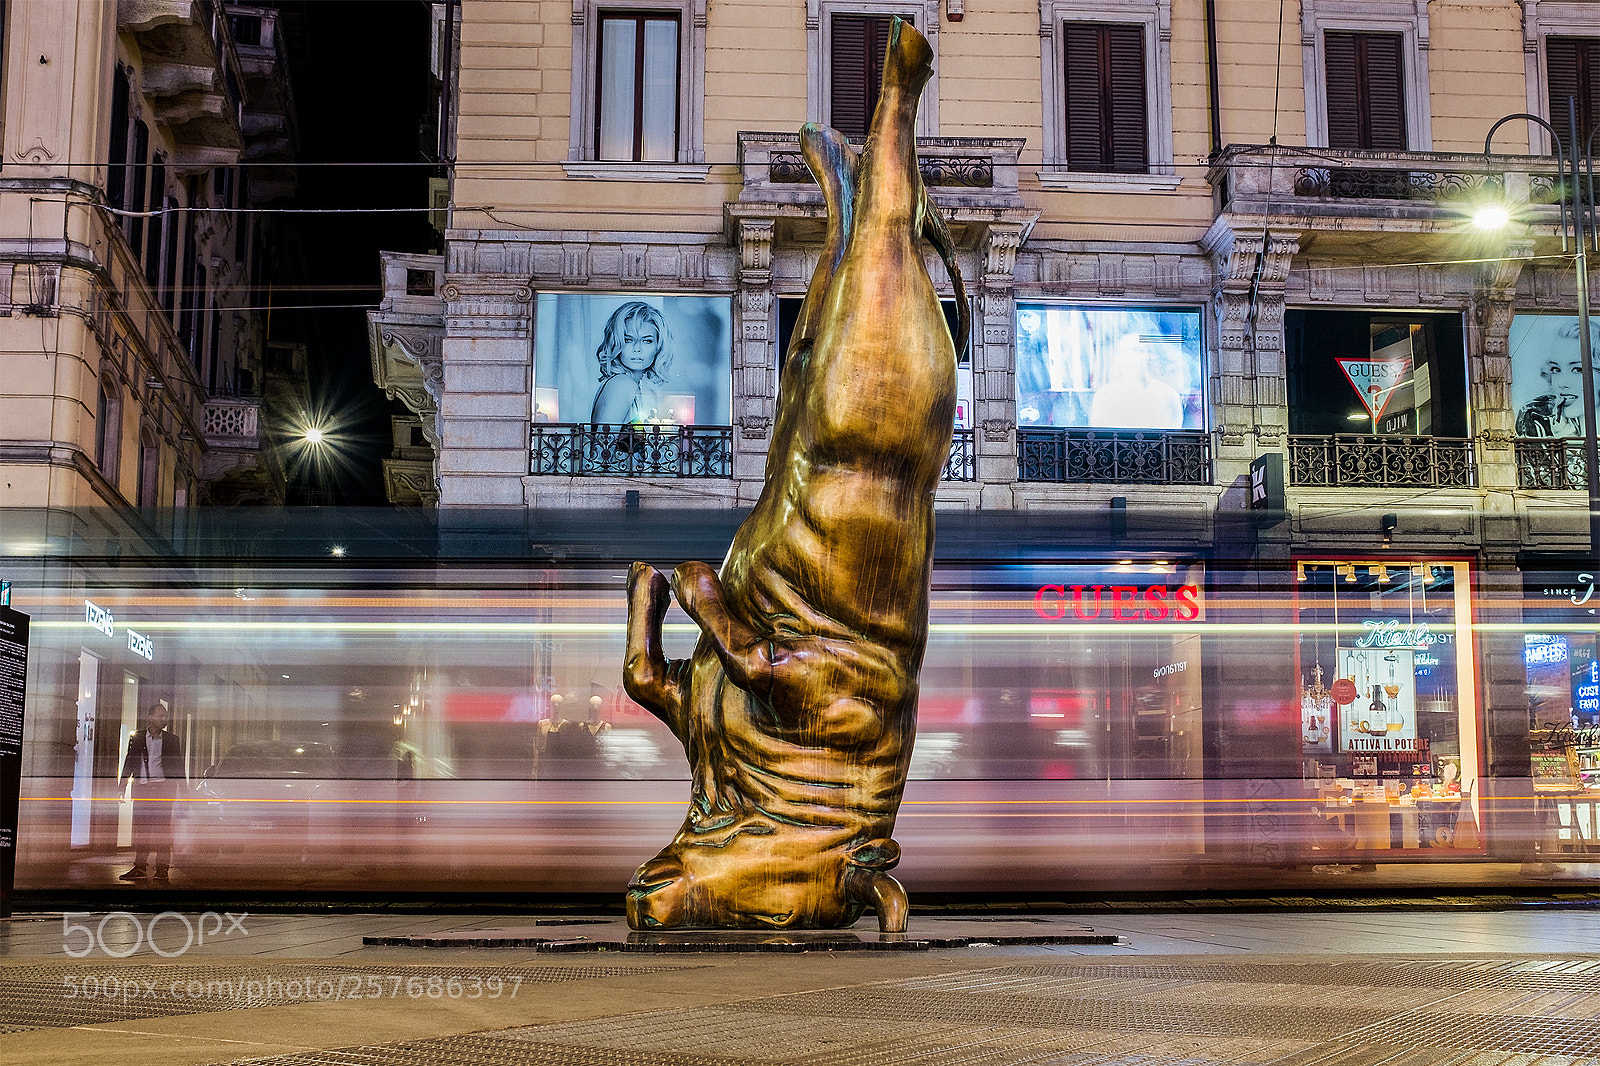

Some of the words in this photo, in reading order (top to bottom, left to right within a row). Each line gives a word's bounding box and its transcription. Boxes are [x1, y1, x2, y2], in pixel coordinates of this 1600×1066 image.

[1348, 363, 1401, 378] GUES
[1034, 584, 1199, 620] GUESS
[1543, 588, 1577, 596] SINCE
[85, 599, 114, 638] TEZENIS
[126, 628, 154, 661] TEZENIS
[1348, 738, 1381, 750] ATTIVA
[1384, 738, 1393, 750] IL
[1394, 737, 1430, 750] POTERE
